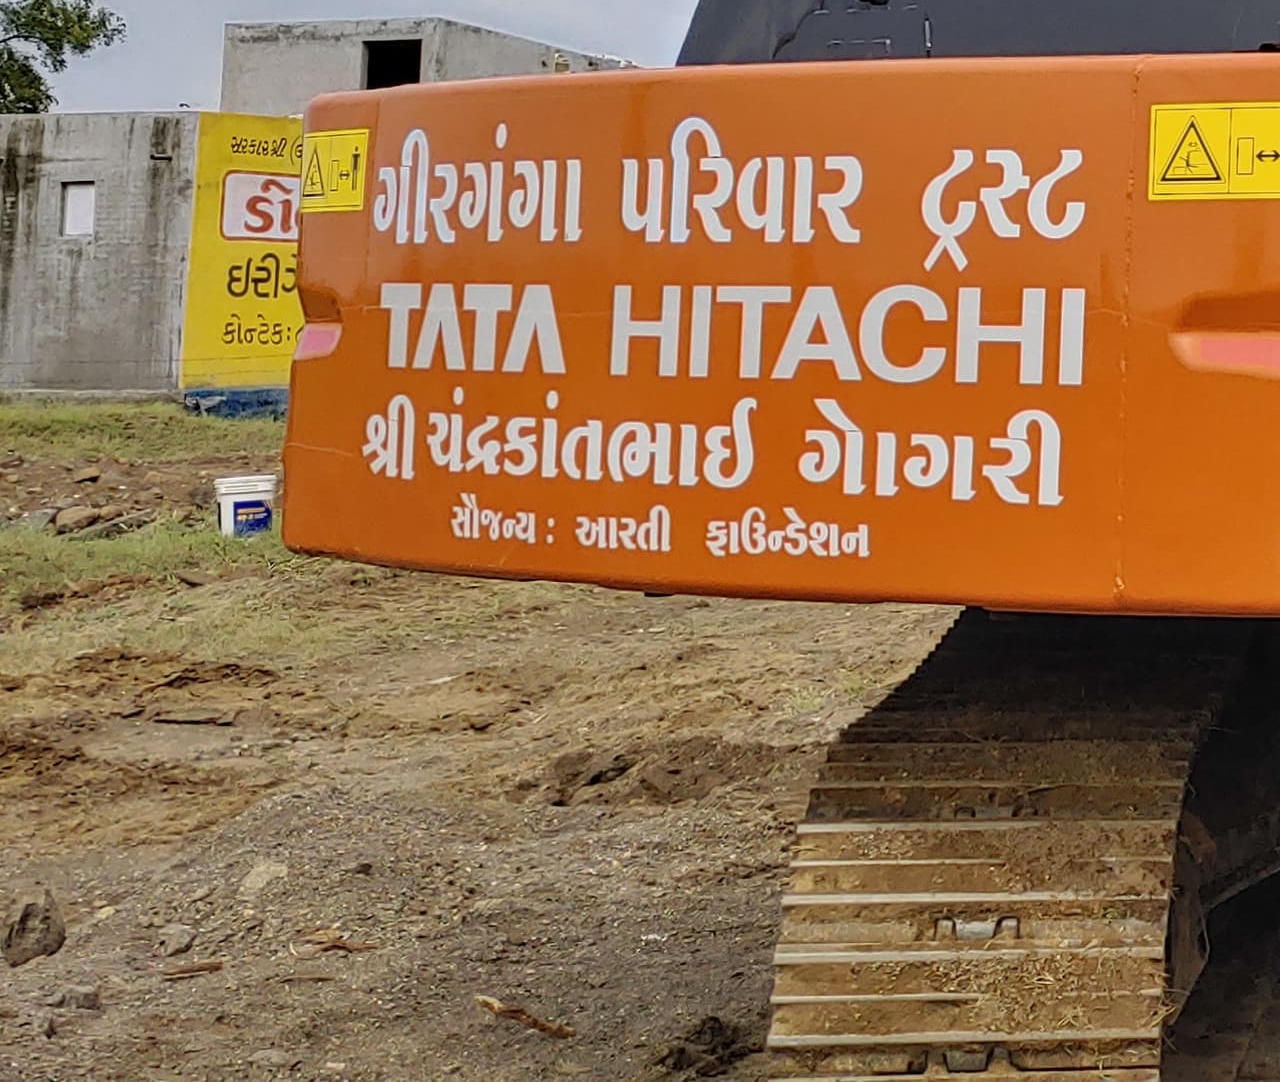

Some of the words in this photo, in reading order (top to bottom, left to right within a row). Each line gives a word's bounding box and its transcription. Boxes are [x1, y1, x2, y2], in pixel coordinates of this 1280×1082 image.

[373, 123, 582, 245] ગીરગંગા
[621, 115, 865, 244] પરિવાર
[921, 148, 1087, 272] ટ્રસ્ટ
[380, 282, 566, 374] TATA
[610, 285, 1087, 386] HITACHI
[362, 393, 416, 481] શ્રી
[426, 386, 758, 489] ચંદ્રકાંતભાઈ
[798, 398, 1064, 507] ગોગરી
[451, 493, 537, 545] સૌજન્ય
[574, 504, 672, 553] આરતી
[705, 506, 871, 559] ફાઉન્ડેશન
